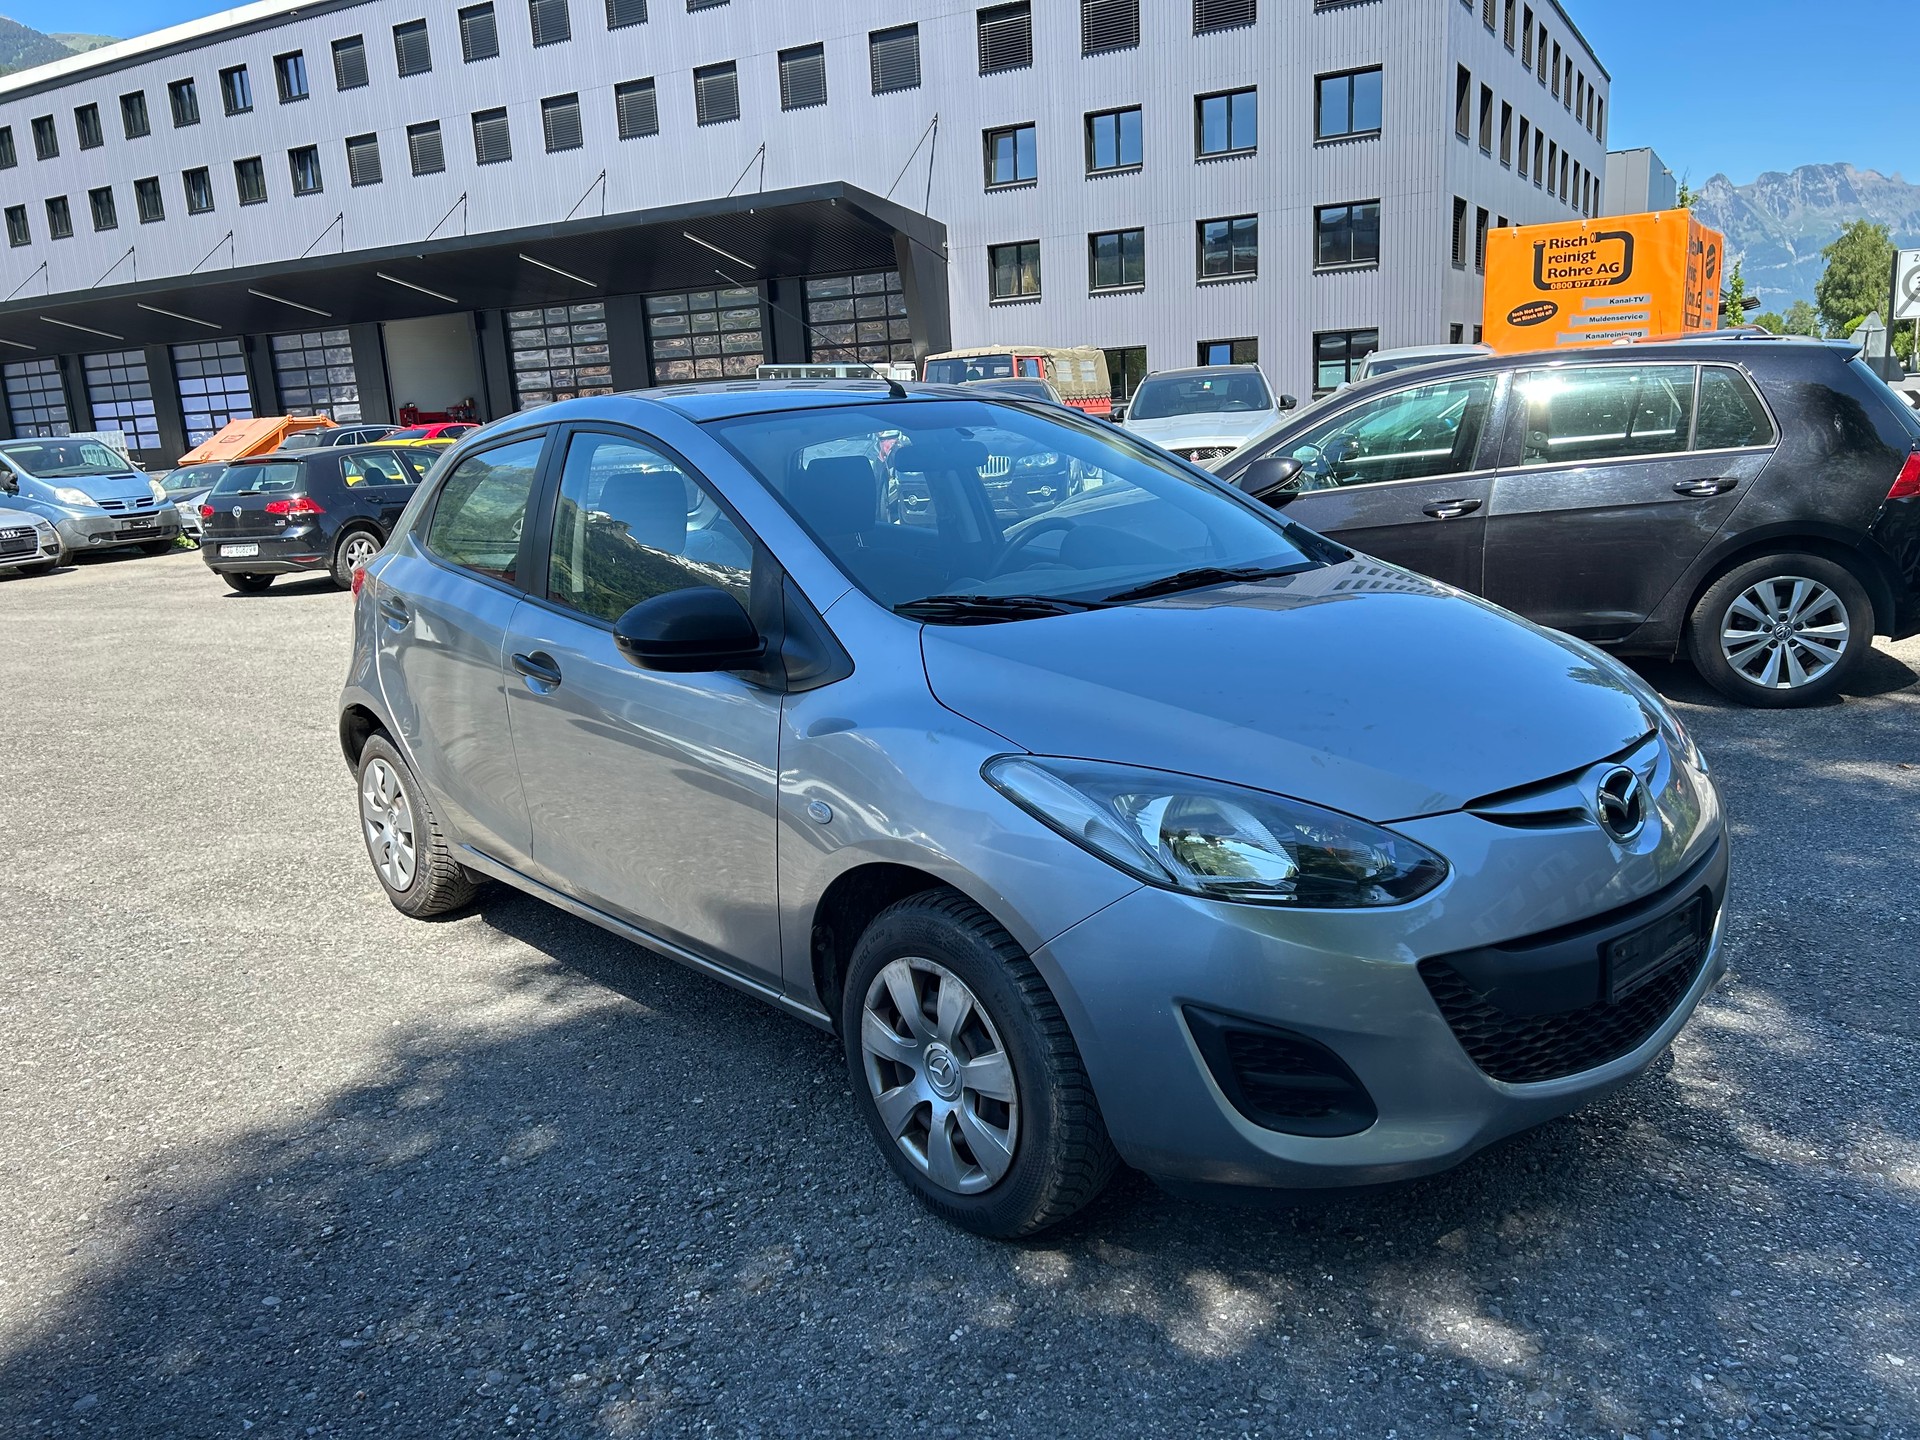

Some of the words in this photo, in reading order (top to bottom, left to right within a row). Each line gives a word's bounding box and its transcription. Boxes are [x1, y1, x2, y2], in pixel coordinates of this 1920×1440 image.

[1549, 236, 1588, 250] Risch
[1548, 250, 1597, 264] reinigt
[1547, 266, 1593, 279] Rohre
[1596, 262, 1620, 274] AG
[1550, 282, 1573, 290] 0800
[1574, 280, 1592, 288] 077
[1593, 278, 1612, 286] 077
[1609, 296, 1645, 305] Kanal-TV
[1588, 314, 1644, 323] Muldenservice
